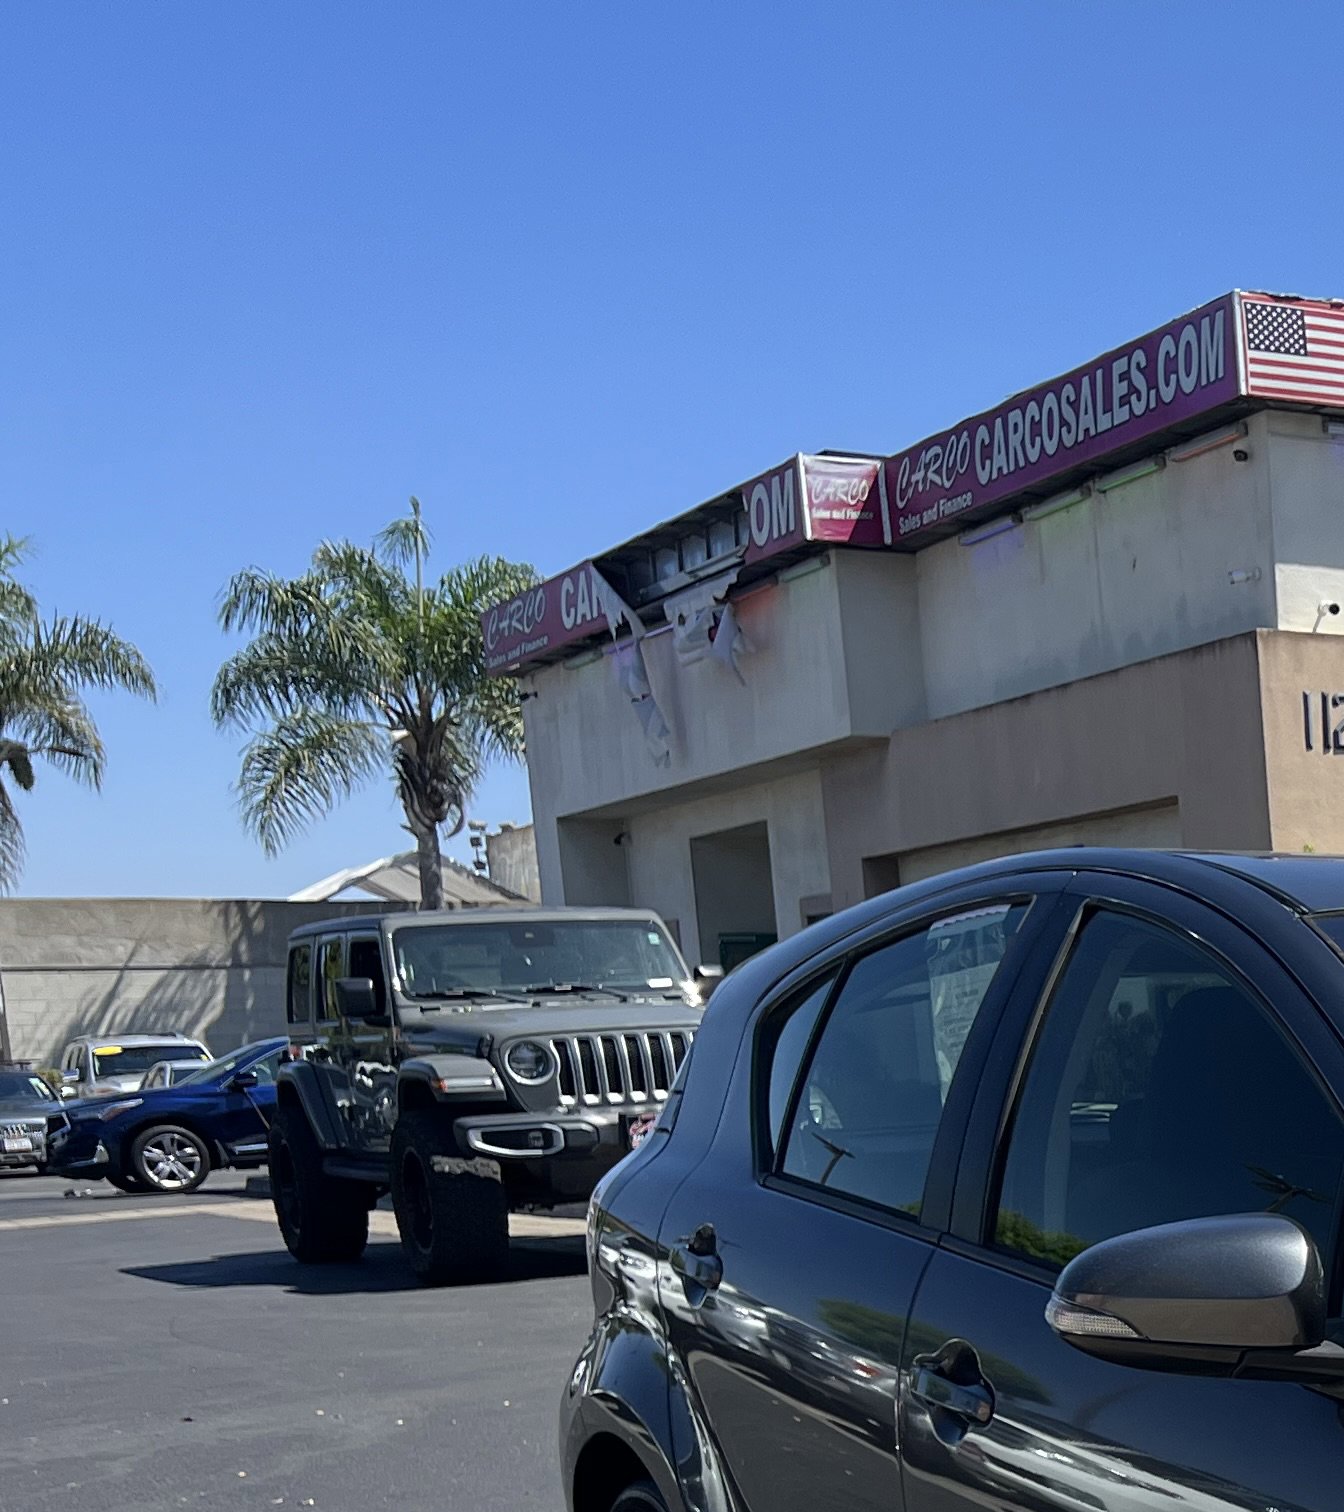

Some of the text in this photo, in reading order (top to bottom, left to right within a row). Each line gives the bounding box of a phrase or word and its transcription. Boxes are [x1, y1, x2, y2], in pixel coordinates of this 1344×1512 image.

[974, 309, 1226, 487] CARCOSALES.COM
[812, 479, 870, 507] CARCO
[896, 430, 971, 510] CARCO
[743, 468, 796, 547] OM
[899, 491, 973, 535] Sales and Finance
[487, 587, 547, 651] CARCO
